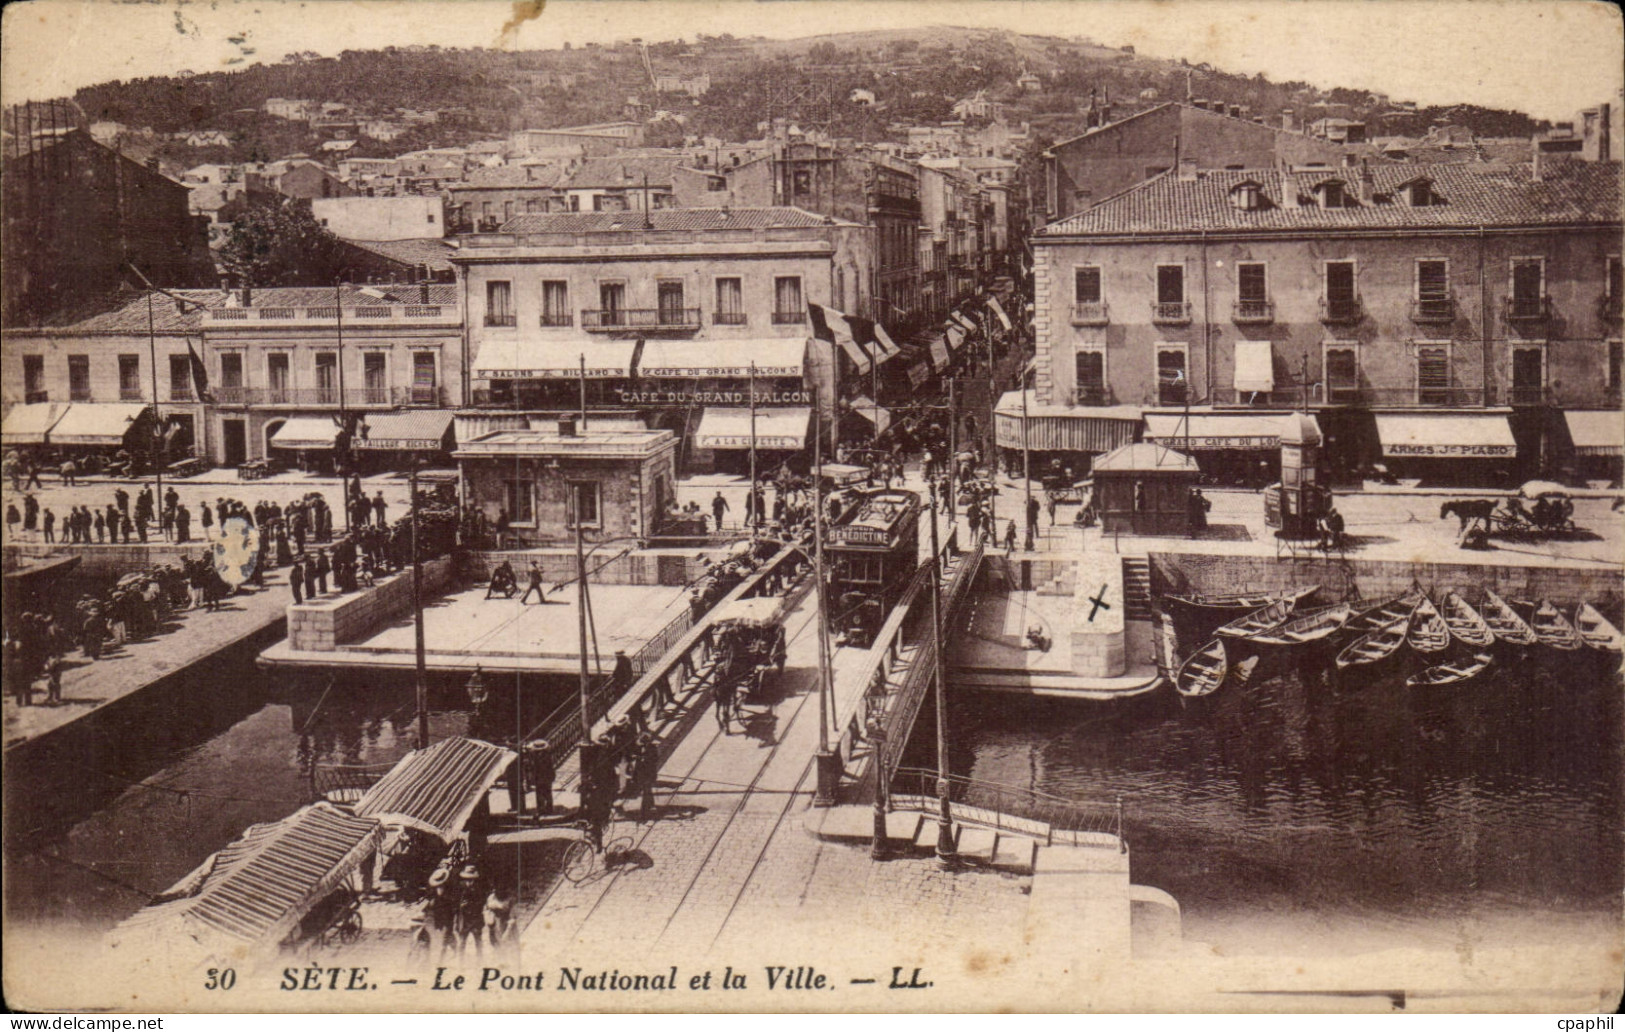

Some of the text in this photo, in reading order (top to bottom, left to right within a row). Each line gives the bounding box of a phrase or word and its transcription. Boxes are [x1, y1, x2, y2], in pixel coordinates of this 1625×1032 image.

[492, 368, 608, 378] SALONS BILLARD
[654, 367, 681, 377] CAFE
[687, 367, 700, 376] DU
[706, 366, 740, 376] GRAND
[620, 391, 811, 403] CAFE DU GRAND BALCON
[1204, 438, 1232, 446] CAFE
[1239, 438, 1253, 446] DU
[204, 968, 237, 991] 30
[280, 962, 378, 991] SÈTE.
[431, 967, 465, 991] Le
[478, 967, 545, 991] Pont
[556, 966, 678, 991] National
[689, 968, 711, 990] et
[722, 966, 747, 990] la
[764, 966, 836, 991] Ville.
